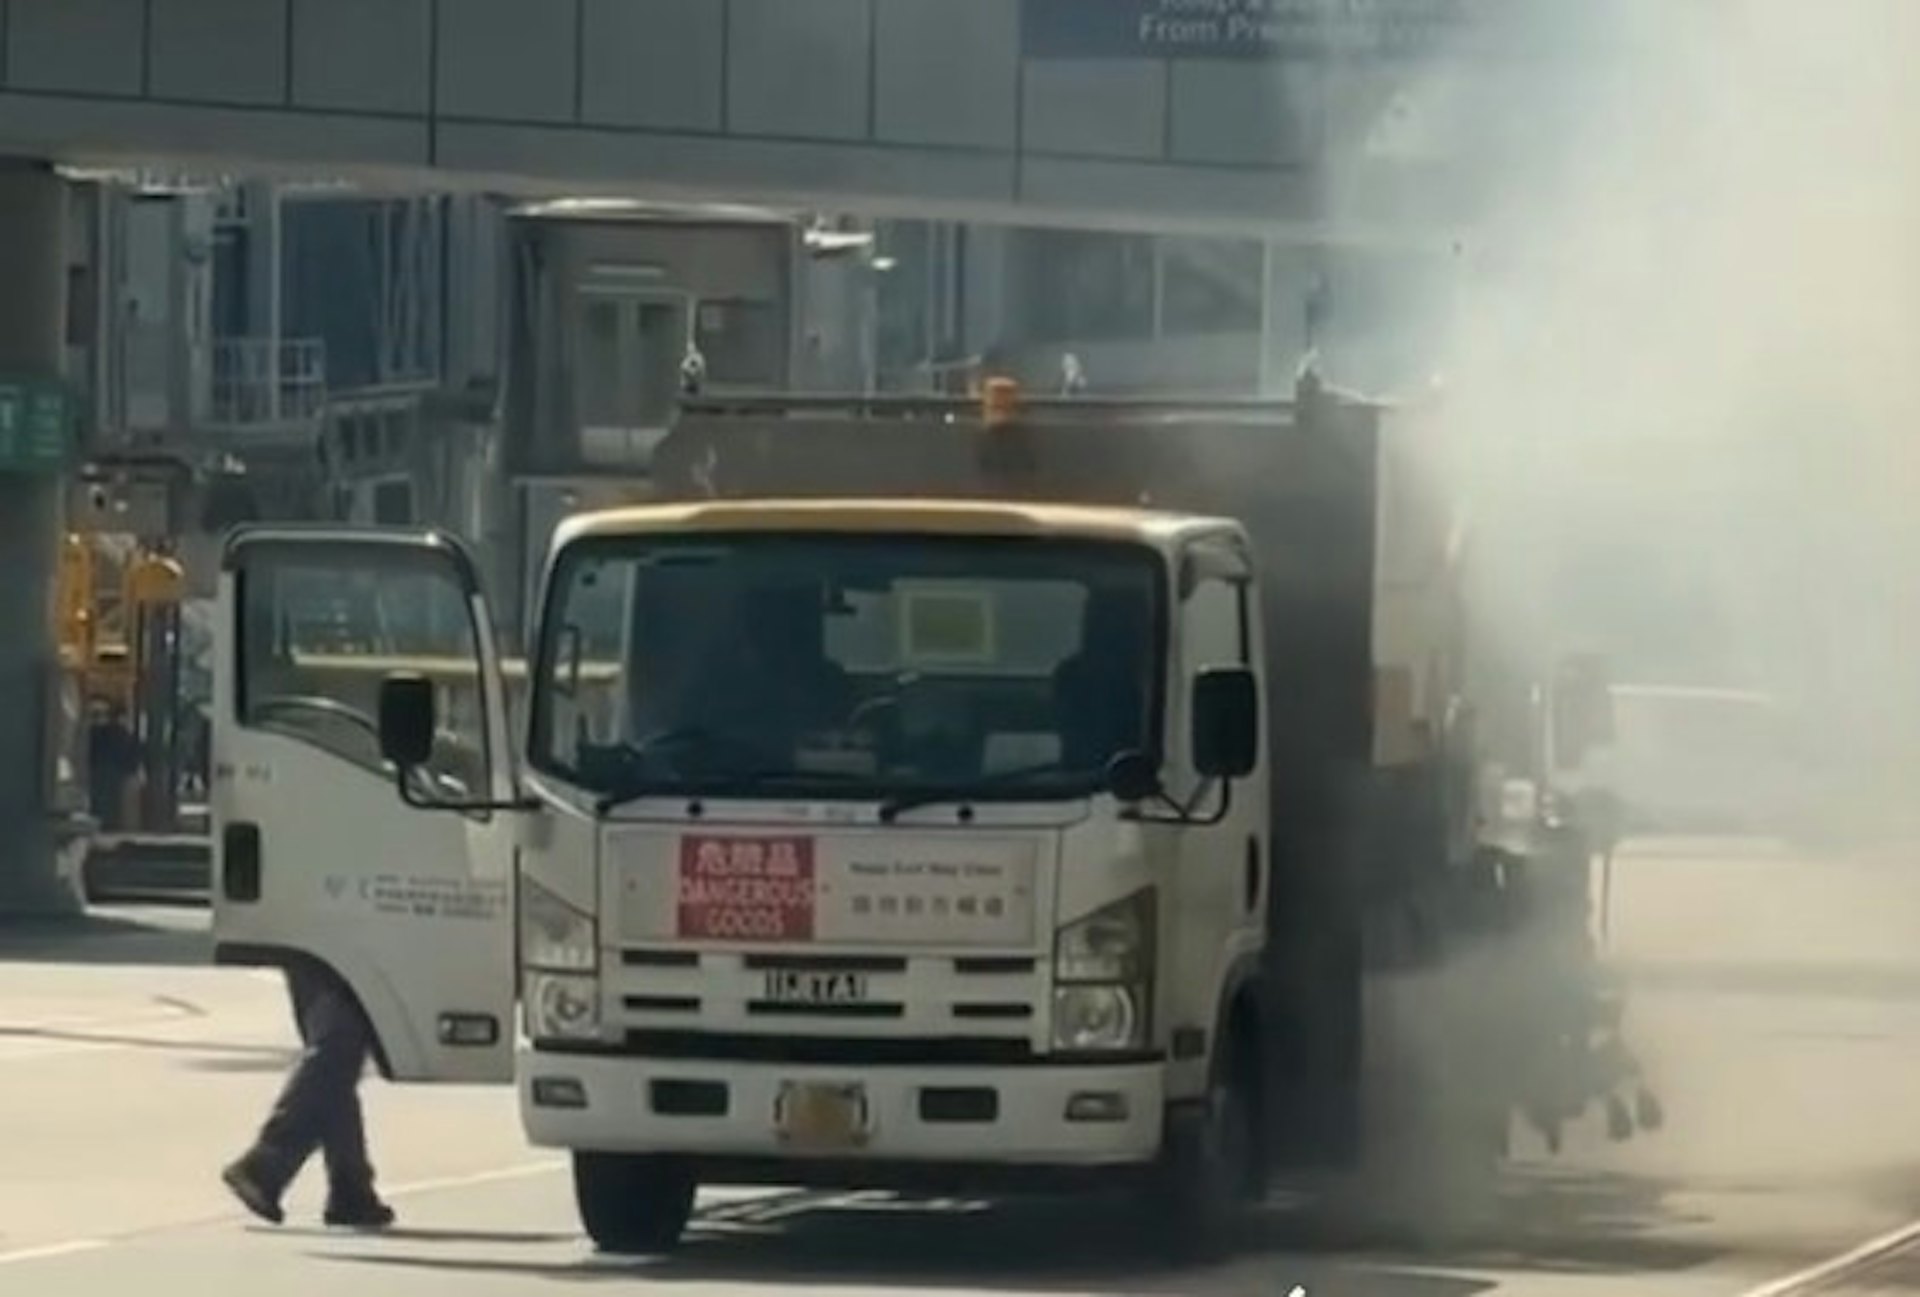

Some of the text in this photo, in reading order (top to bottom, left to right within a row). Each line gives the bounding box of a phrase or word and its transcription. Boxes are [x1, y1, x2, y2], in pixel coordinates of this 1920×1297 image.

[1139, 13, 1219, 43] From
[680, 876, 814, 906] DANGEROUS
[707, 907, 786, 938] GOODS
